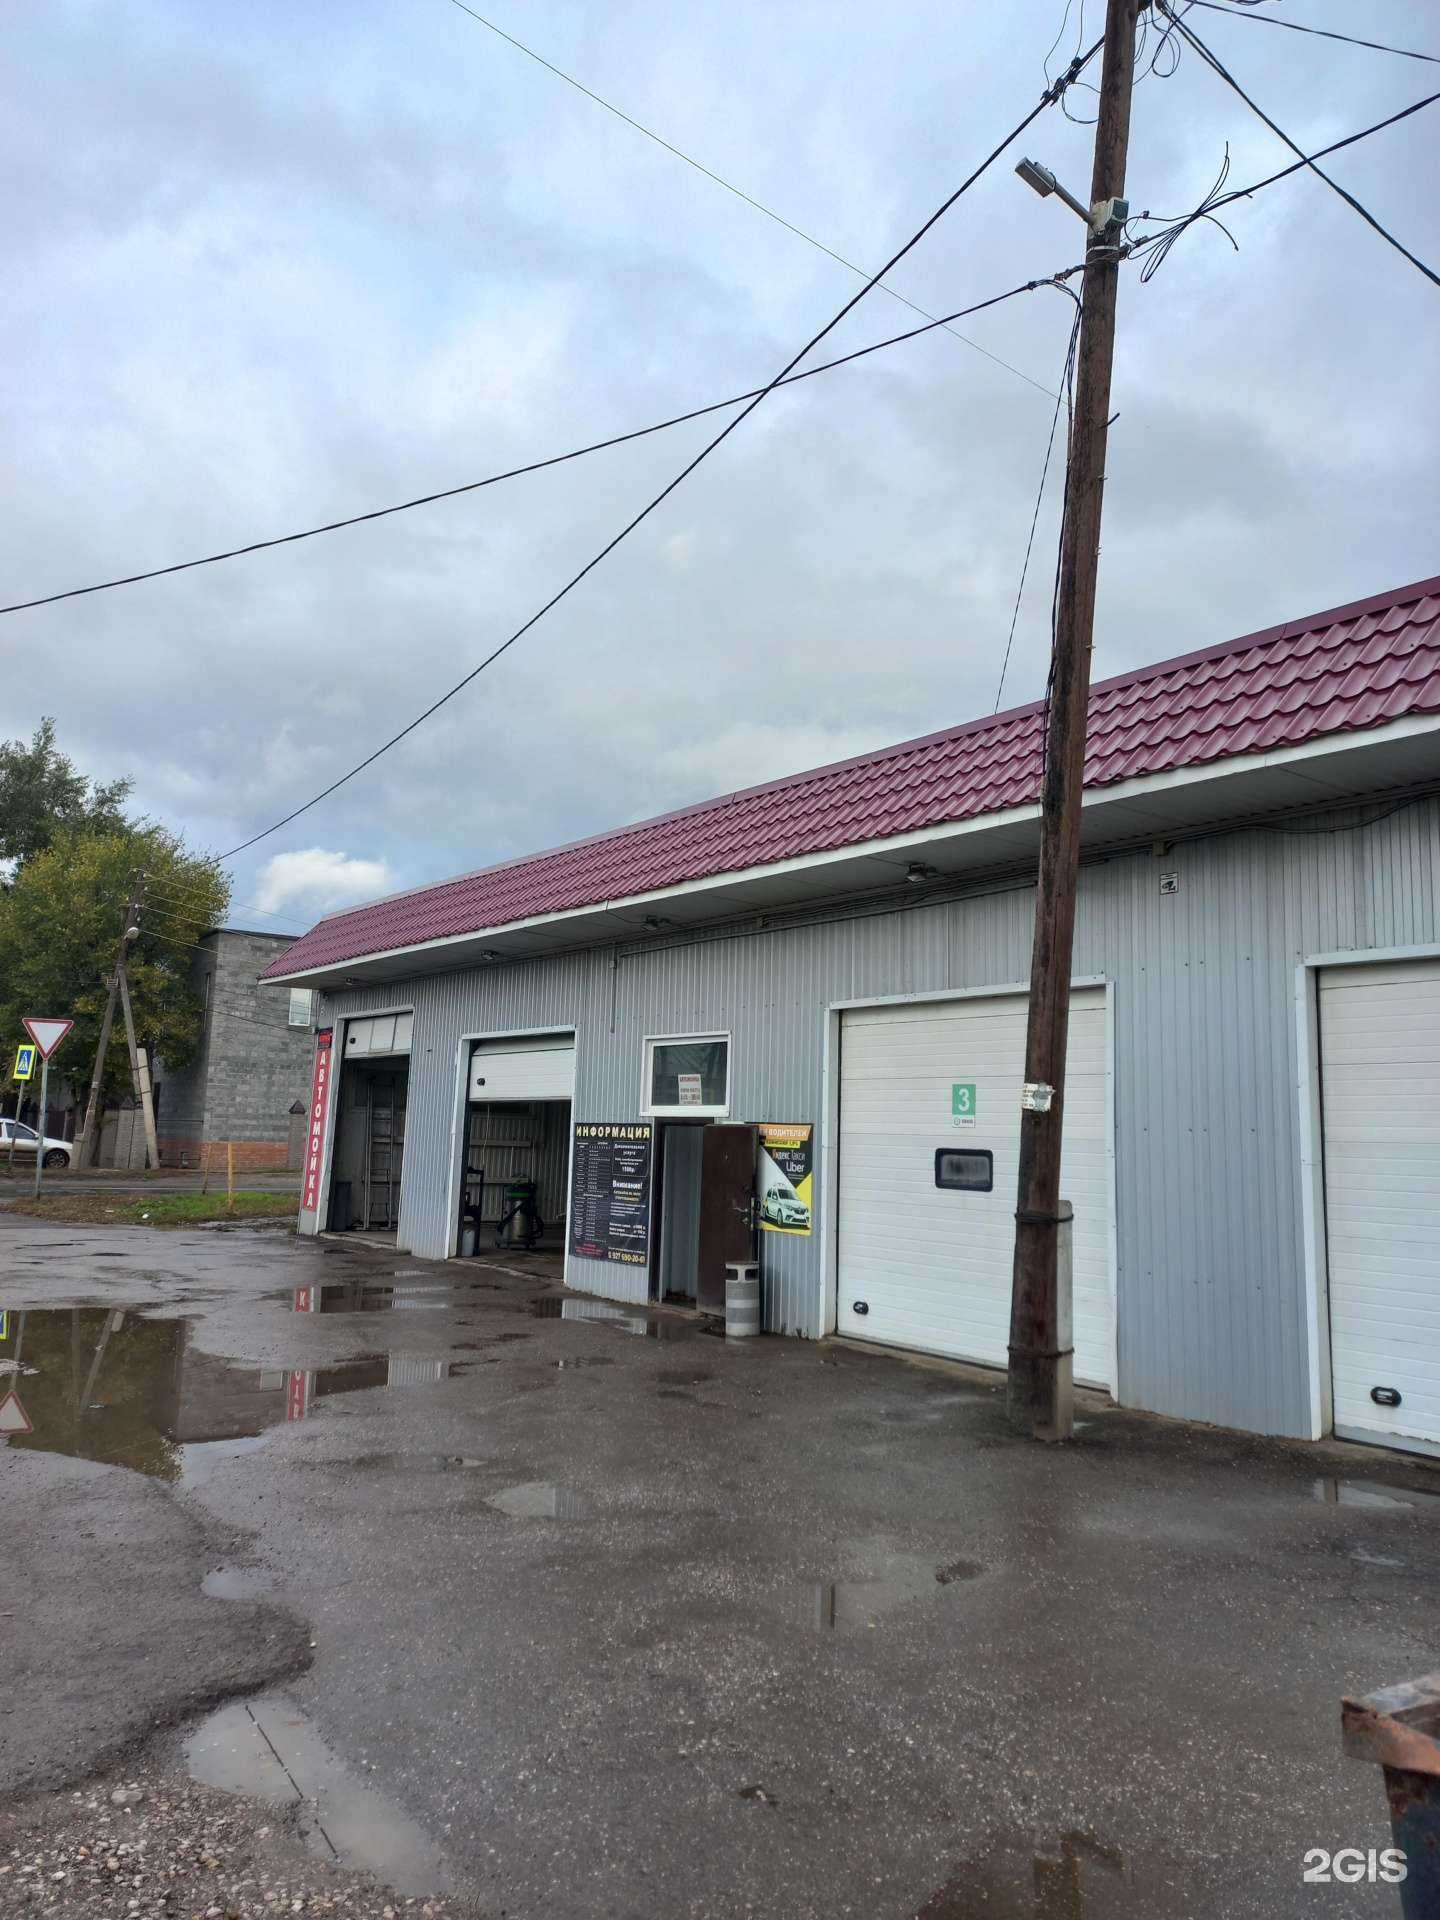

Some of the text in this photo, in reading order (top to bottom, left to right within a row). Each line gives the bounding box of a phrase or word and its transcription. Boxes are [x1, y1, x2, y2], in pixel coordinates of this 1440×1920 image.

[958, 1088, 970, 1111] 3
[307, 1050, 326, 1207] АВТОМОЙКА
[576, 1126, 650, 1140] ИНФОРМАЦИЯ
[786, 1161, 804, 1172] Uber
[612, 1180, 642, 1189] Внимание!
